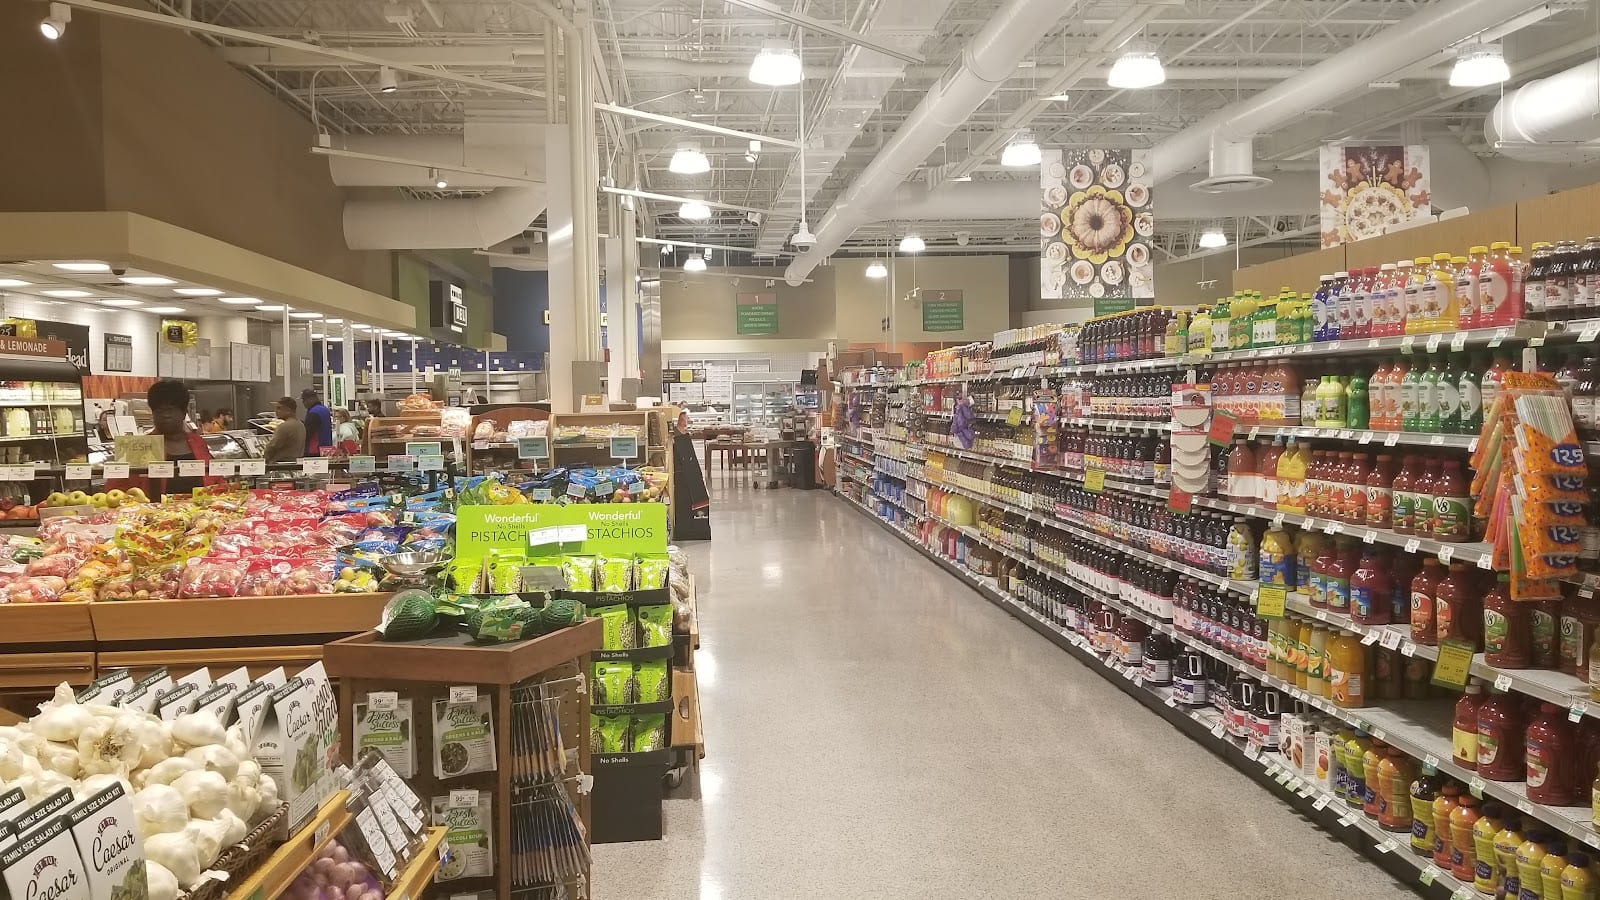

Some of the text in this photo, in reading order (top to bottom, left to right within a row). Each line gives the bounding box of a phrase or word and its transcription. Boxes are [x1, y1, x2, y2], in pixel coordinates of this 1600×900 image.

[754, 295, 760, 304] 1
[939, 292, 945, 300] 2
[8, 341, 48, 353] LEMONADE
[1552, 448, 1584, 464] 125
[1436, 497, 1448, 513] V8
[484, 513, 538, 524] Wonderful
[588, 511, 641, 521] Wonderful
[471, 530, 527, 543] PISTACH
[587, 527, 653, 540] STACHIOS
[1550, 527, 1580, 541] 125
[1562, 618, 1572, 634] V8
[366, 710, 398, 724] Fresh
[446, 705, 475, 721] Fresh
[286, 711, 312, 739] Caesar
[369, 718, 400, 731] Success
[450, 716, 480, 728] Success
[12, 792, 21, 804] KIT
[71, 786, 121, 822] FAMILY SIZE SALAD KIT
[17, 792, 71, 830] FAMILY SIZE SALAD KIT
[445, 807, 475, 822] Fresh
[448, 818, 478, 831] Success
[2, 821, 63, 865] FAMILY SIZE SALAD KIT
[92, 829, 136, 873] Caesar
[106, 856, 130, 876] ORIGINAL
[26, 868, 79, 900] Caesar
